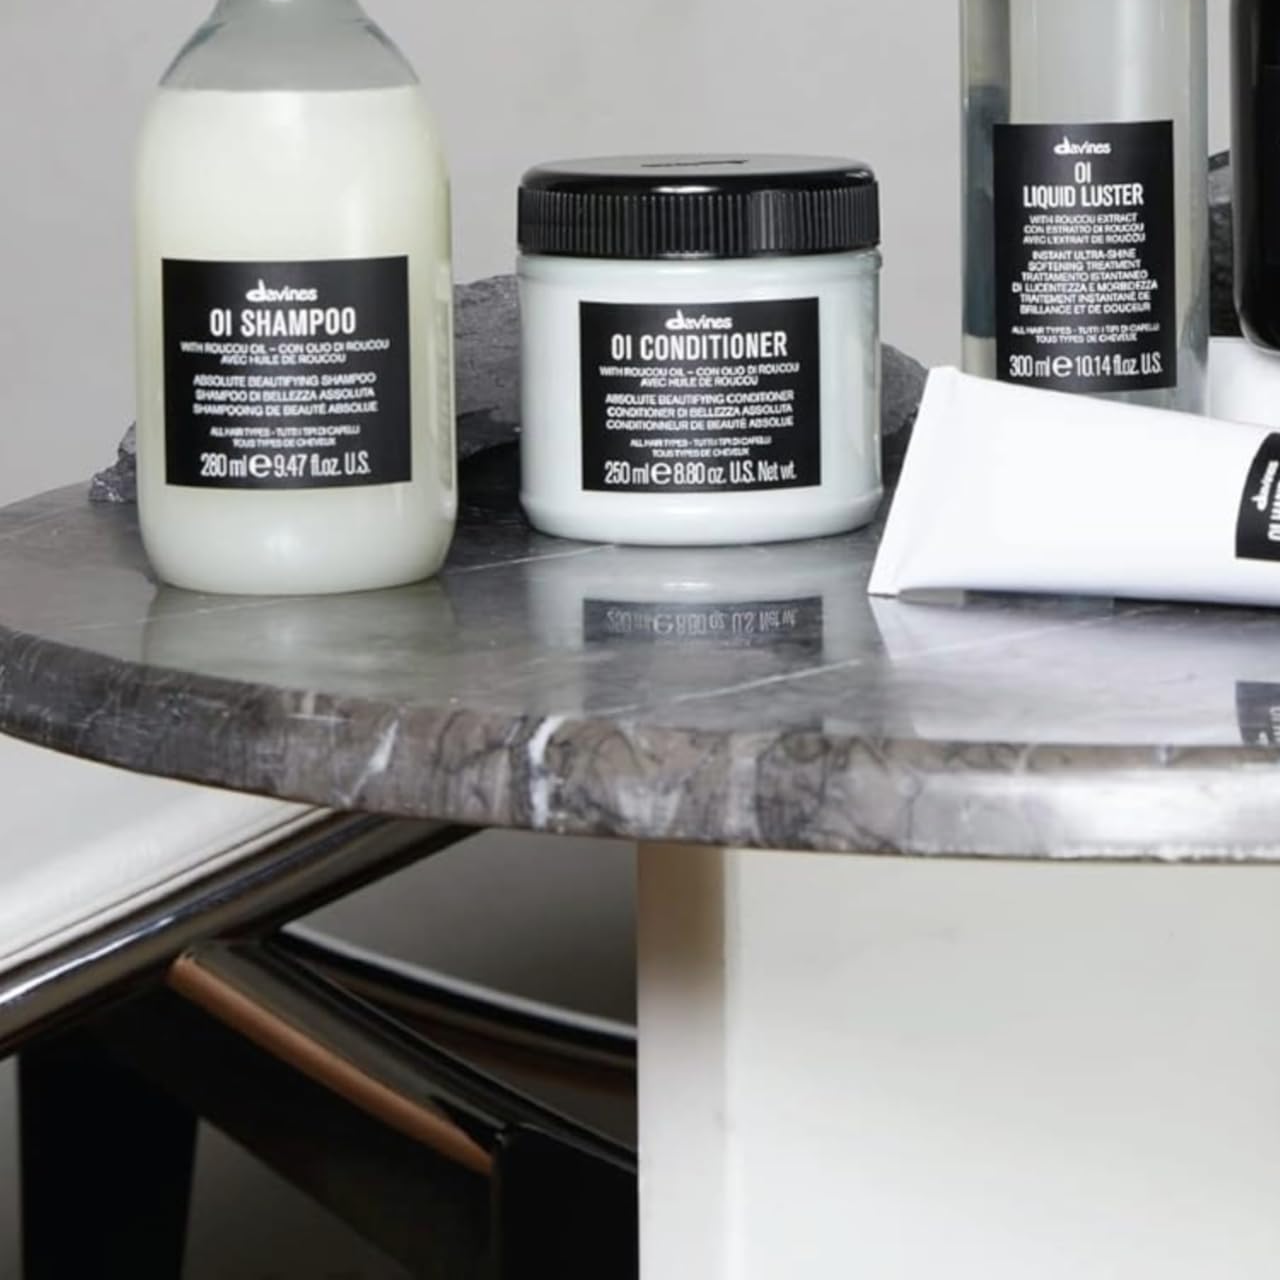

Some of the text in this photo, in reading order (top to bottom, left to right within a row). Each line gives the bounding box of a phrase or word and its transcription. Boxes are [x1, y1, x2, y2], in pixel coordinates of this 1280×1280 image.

[1053, 136, 1112, 155] davines
[1023, 182, 1144, 210] LIQUID LUSTER
[245, 278, 318, 302] davines
[240, 306, 356, 337] SHAMPOO
[664, 309, 733, 331] davines
[640, 330, 788, 361] CONDITIONER
[1009, 354, 1033, 377] 300
[1035, 355, 1050, 377] ml
[200, 452, 227, 477] 280
[229, 454, 247, 477] ml
[273, 453, 308, 478] 9.47
[604, 460, 631, 484] 250
[632, 462, 650, 485] ml
[673, 462, 706, 485] 8.80
[757, 460, 779, 482] Net
